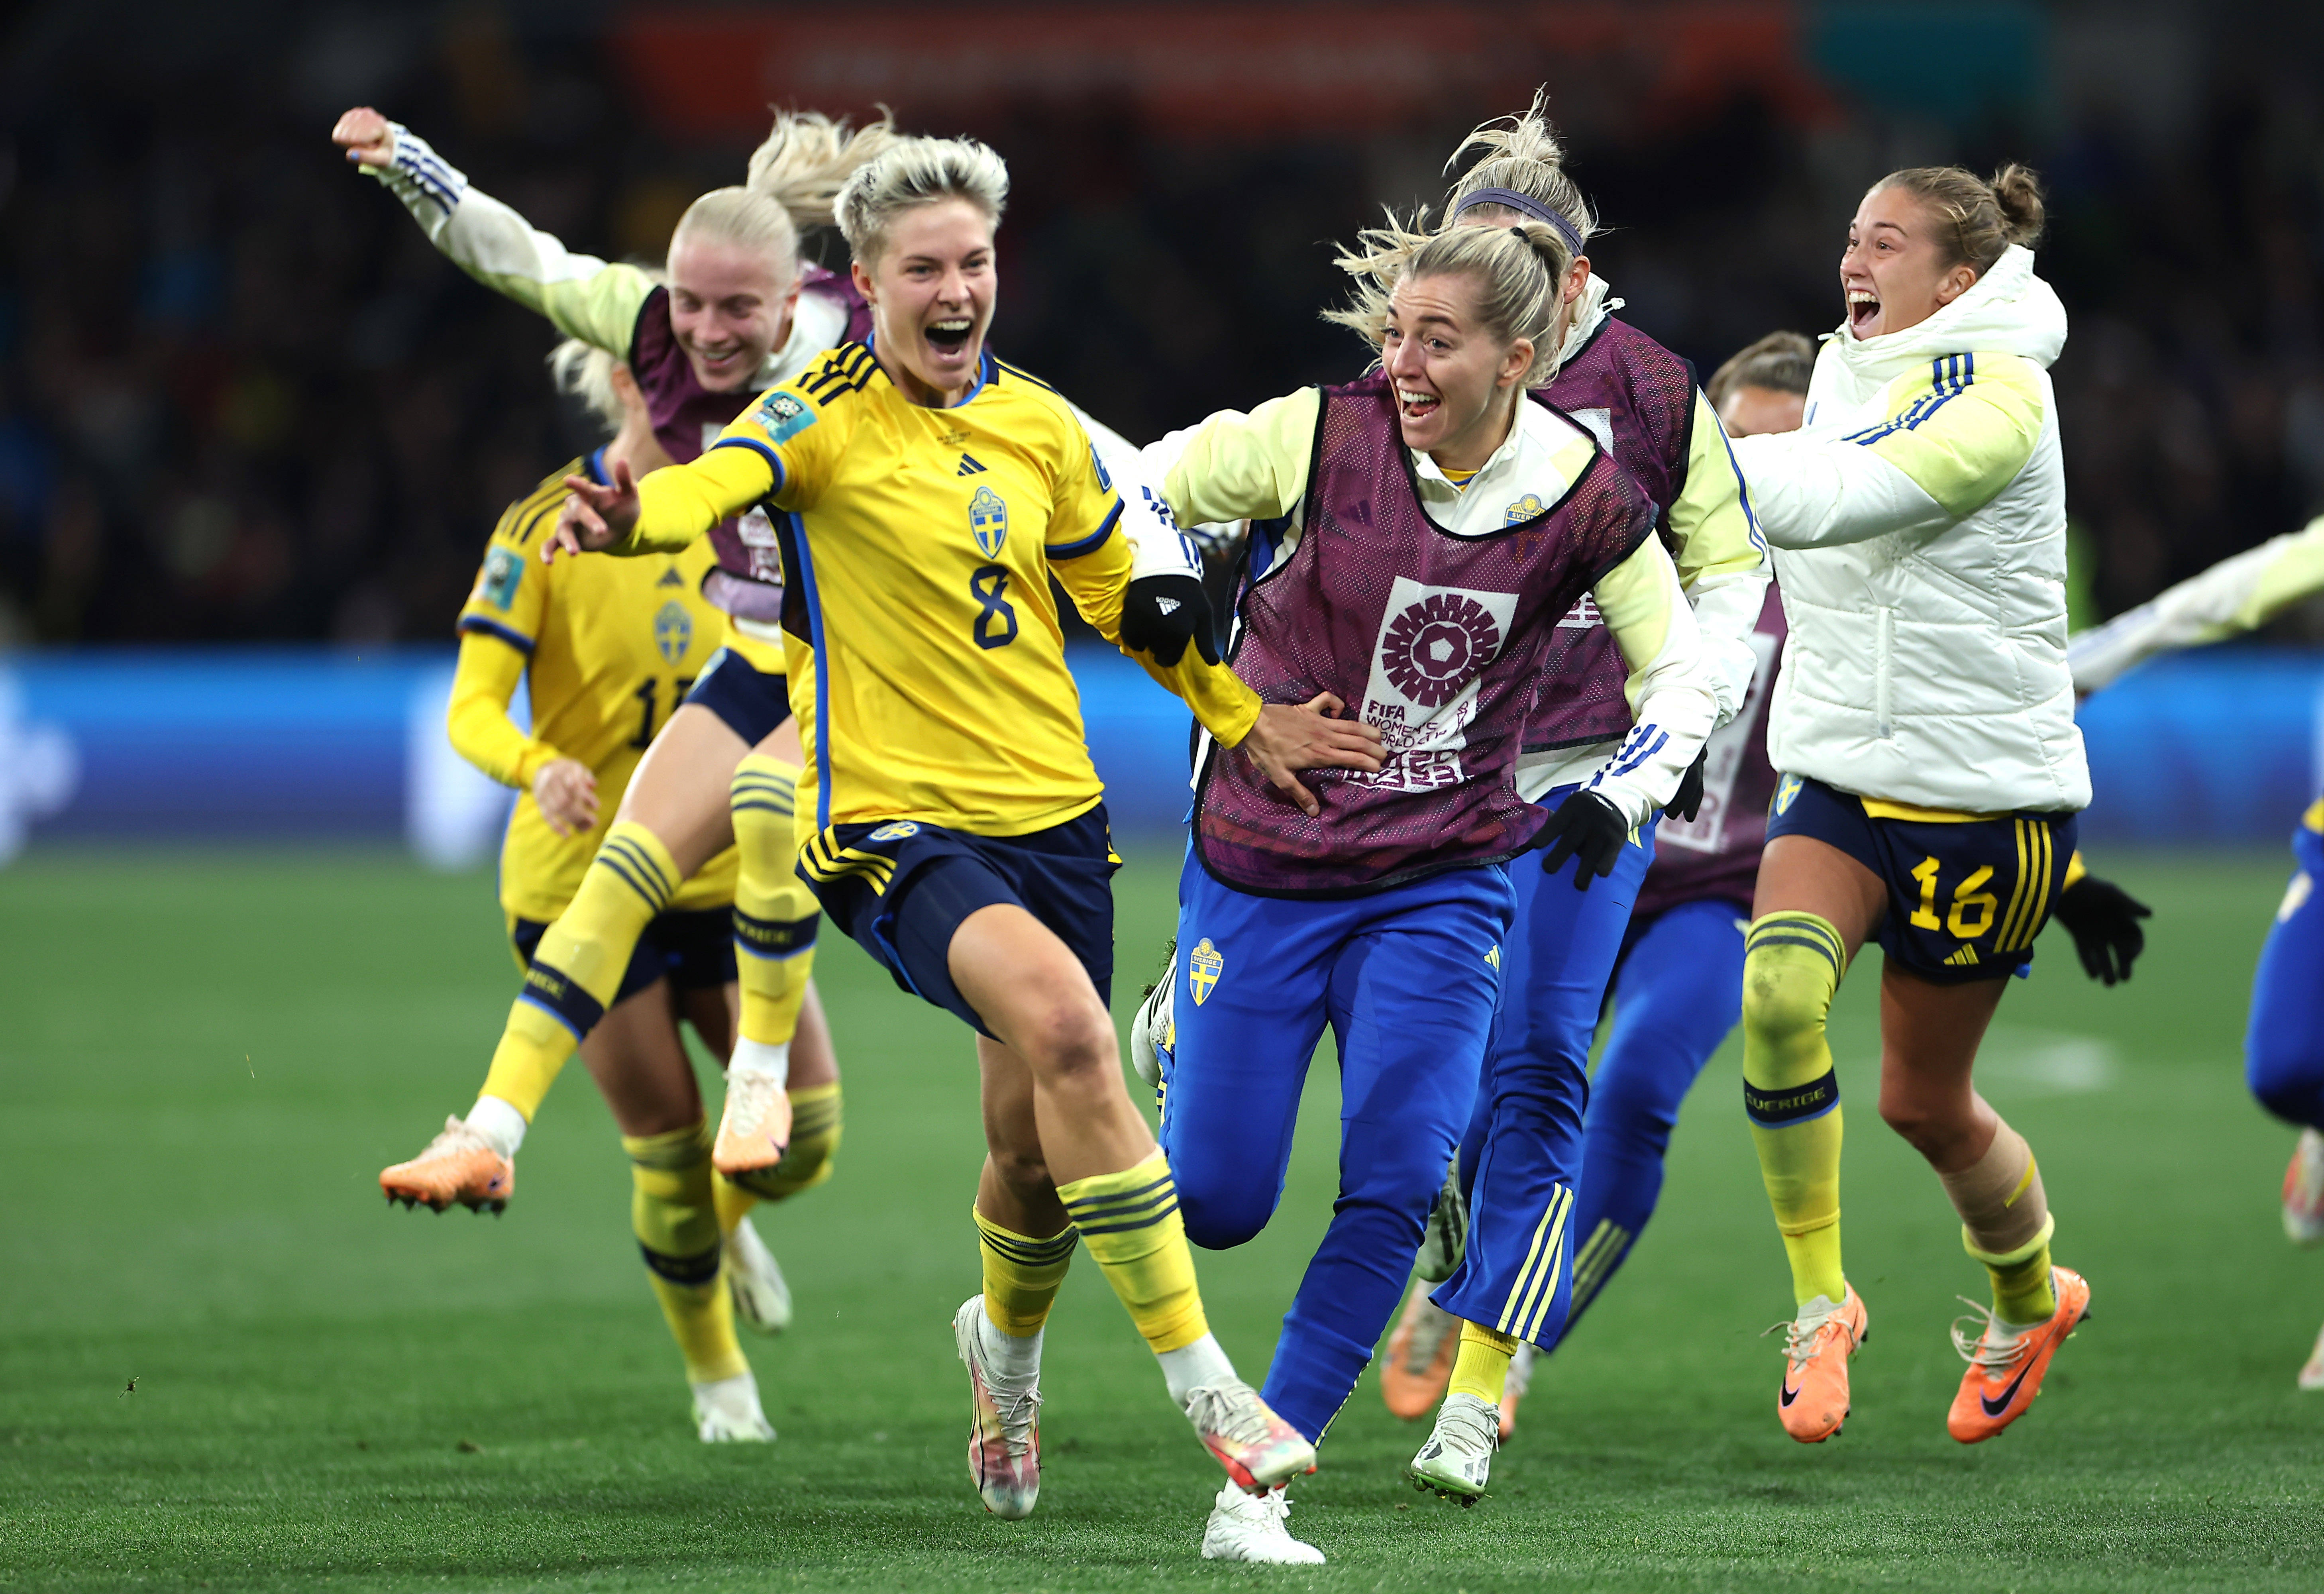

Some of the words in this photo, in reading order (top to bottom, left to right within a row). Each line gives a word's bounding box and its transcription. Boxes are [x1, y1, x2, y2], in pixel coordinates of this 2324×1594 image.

[1512, 512, 1534, 520] SVERI
[970, 565, 1018, 650] 8
[1156, 596, 1182, 607] adidas
[1368, 699, 1405, 722] FIFA
[1380, 732, 1415, 748] ORLD
[1910, 855, 1998, 938] 16
[1194, 956, 1217, 966] SVERIGE
